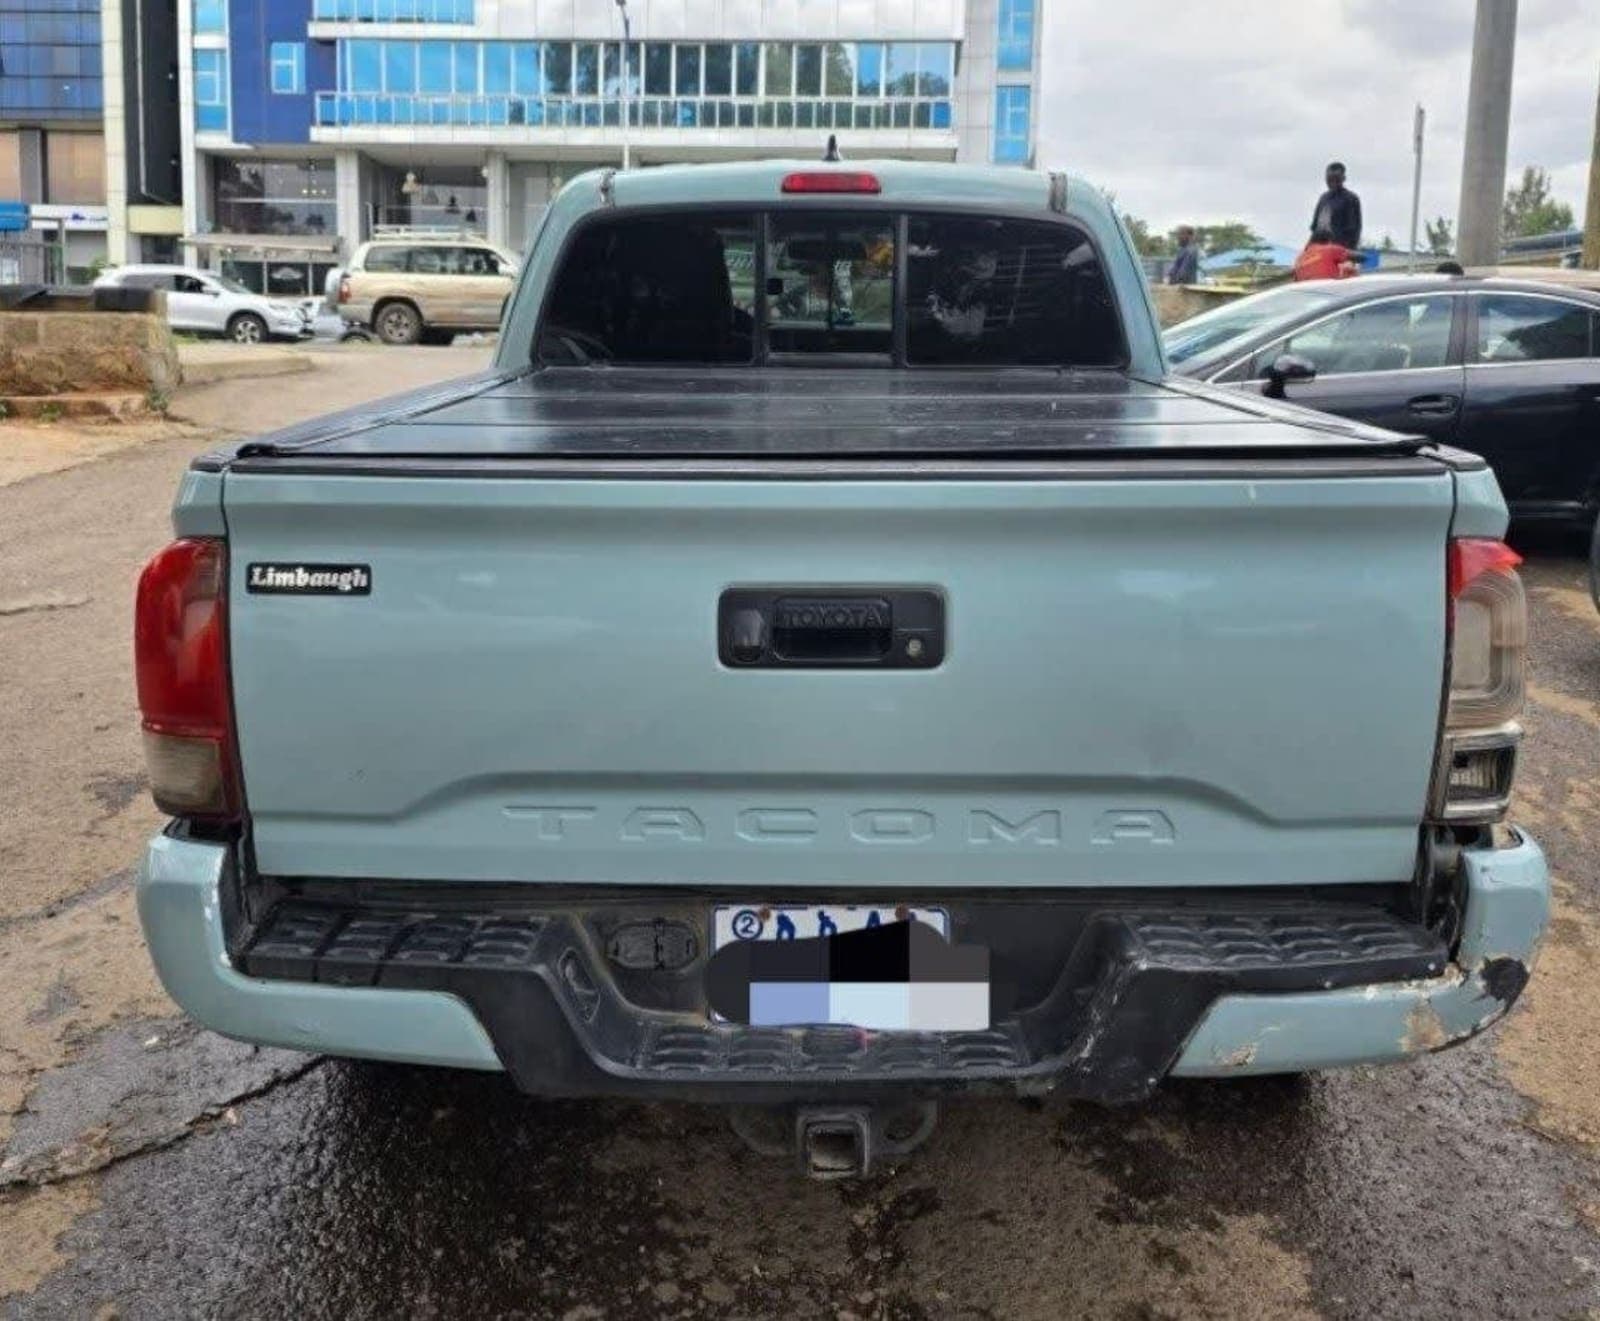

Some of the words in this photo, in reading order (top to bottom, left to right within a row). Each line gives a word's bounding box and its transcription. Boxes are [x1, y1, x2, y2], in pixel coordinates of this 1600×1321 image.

[250, 566, 368, 591] Limbaugh
[782, 605, 883, 629] TOYOTA
[501, 804, 1176, 843] TACOMA
